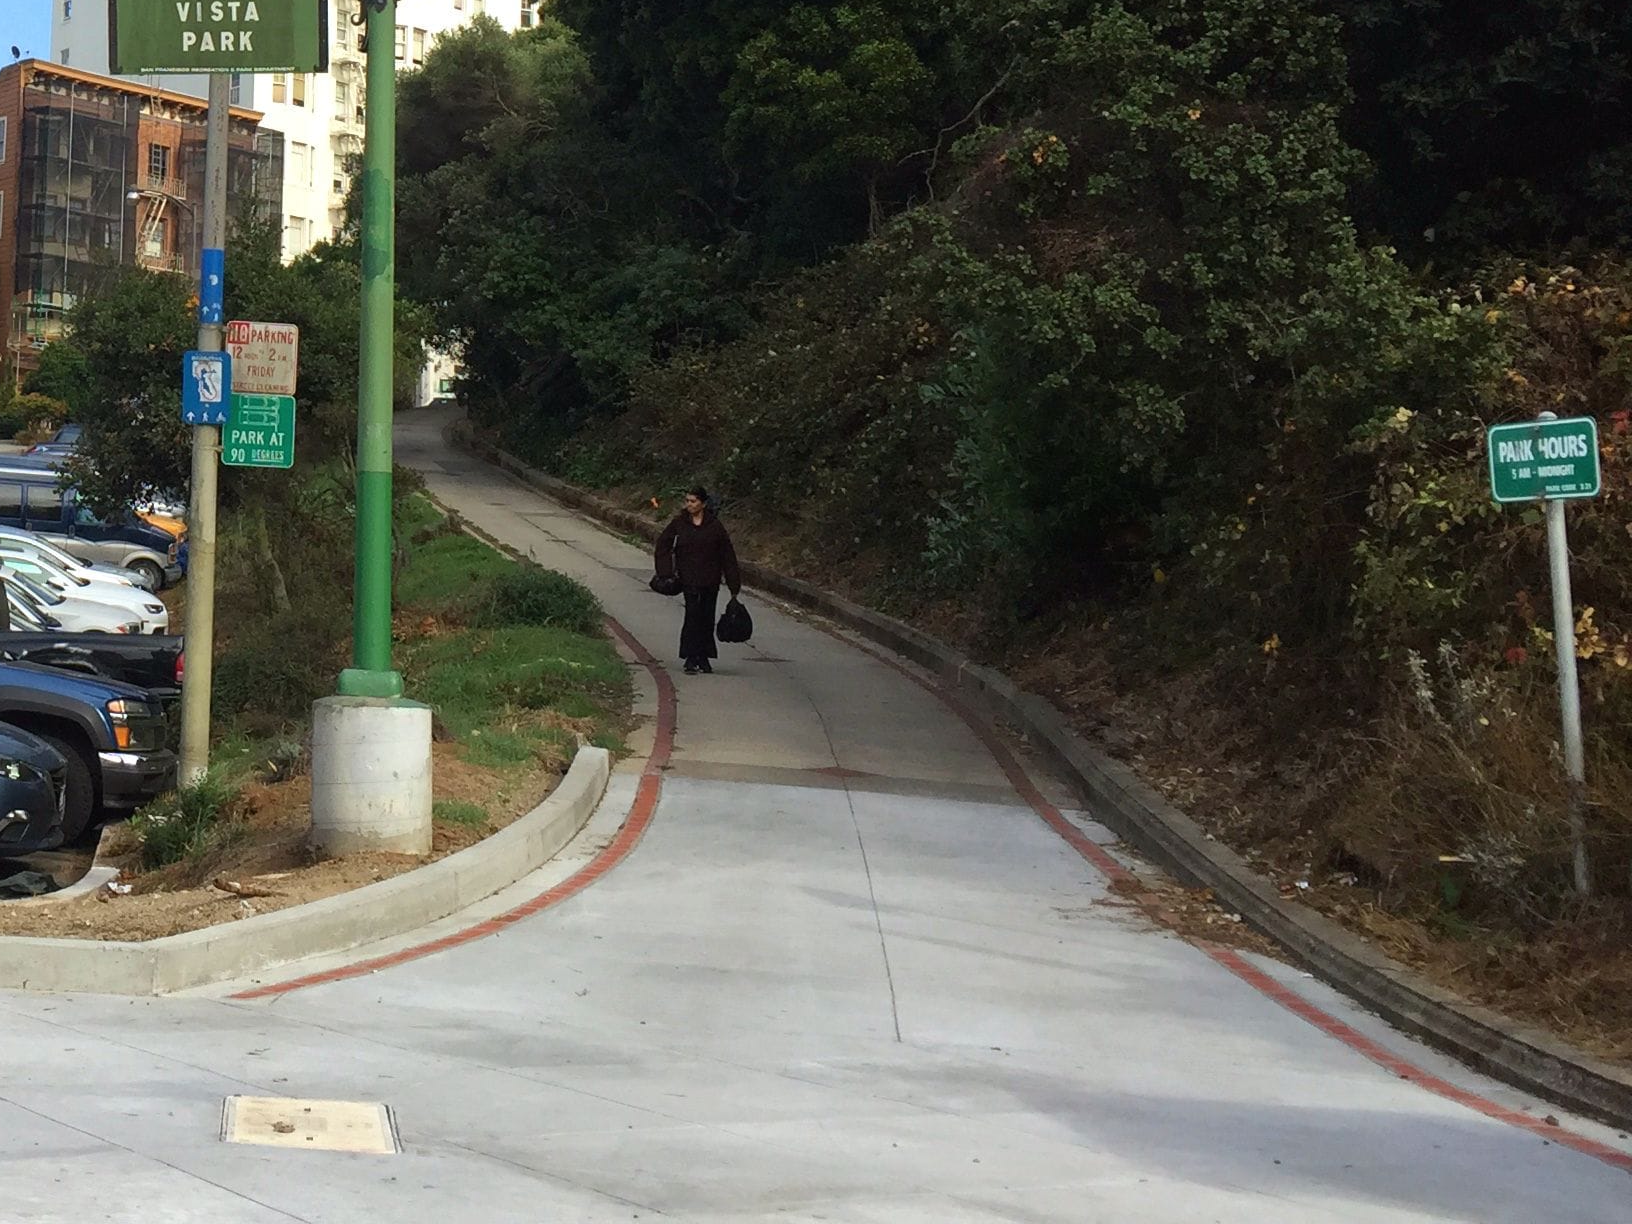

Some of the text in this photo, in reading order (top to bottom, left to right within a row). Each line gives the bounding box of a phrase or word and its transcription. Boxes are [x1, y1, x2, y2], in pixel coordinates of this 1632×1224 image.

[176, 1, 260, 22] VISTA
[182, 31, 253, 52] PARK
[251, 329, 294, 344] PARKING
[232, 346, 243, 360] 12
[269, 348, 276, 361] 2
[247, 365, 276, 377] FRIDAY
[231, 430, 285, 446] PARK AT
[231, 448, 285, 463] 90 DEGREES
[1498, 434, 1588, 463] PARK HOURS
[1512, 469, 1517, 479] 5
[1518, 467, 1532, 479] AM
